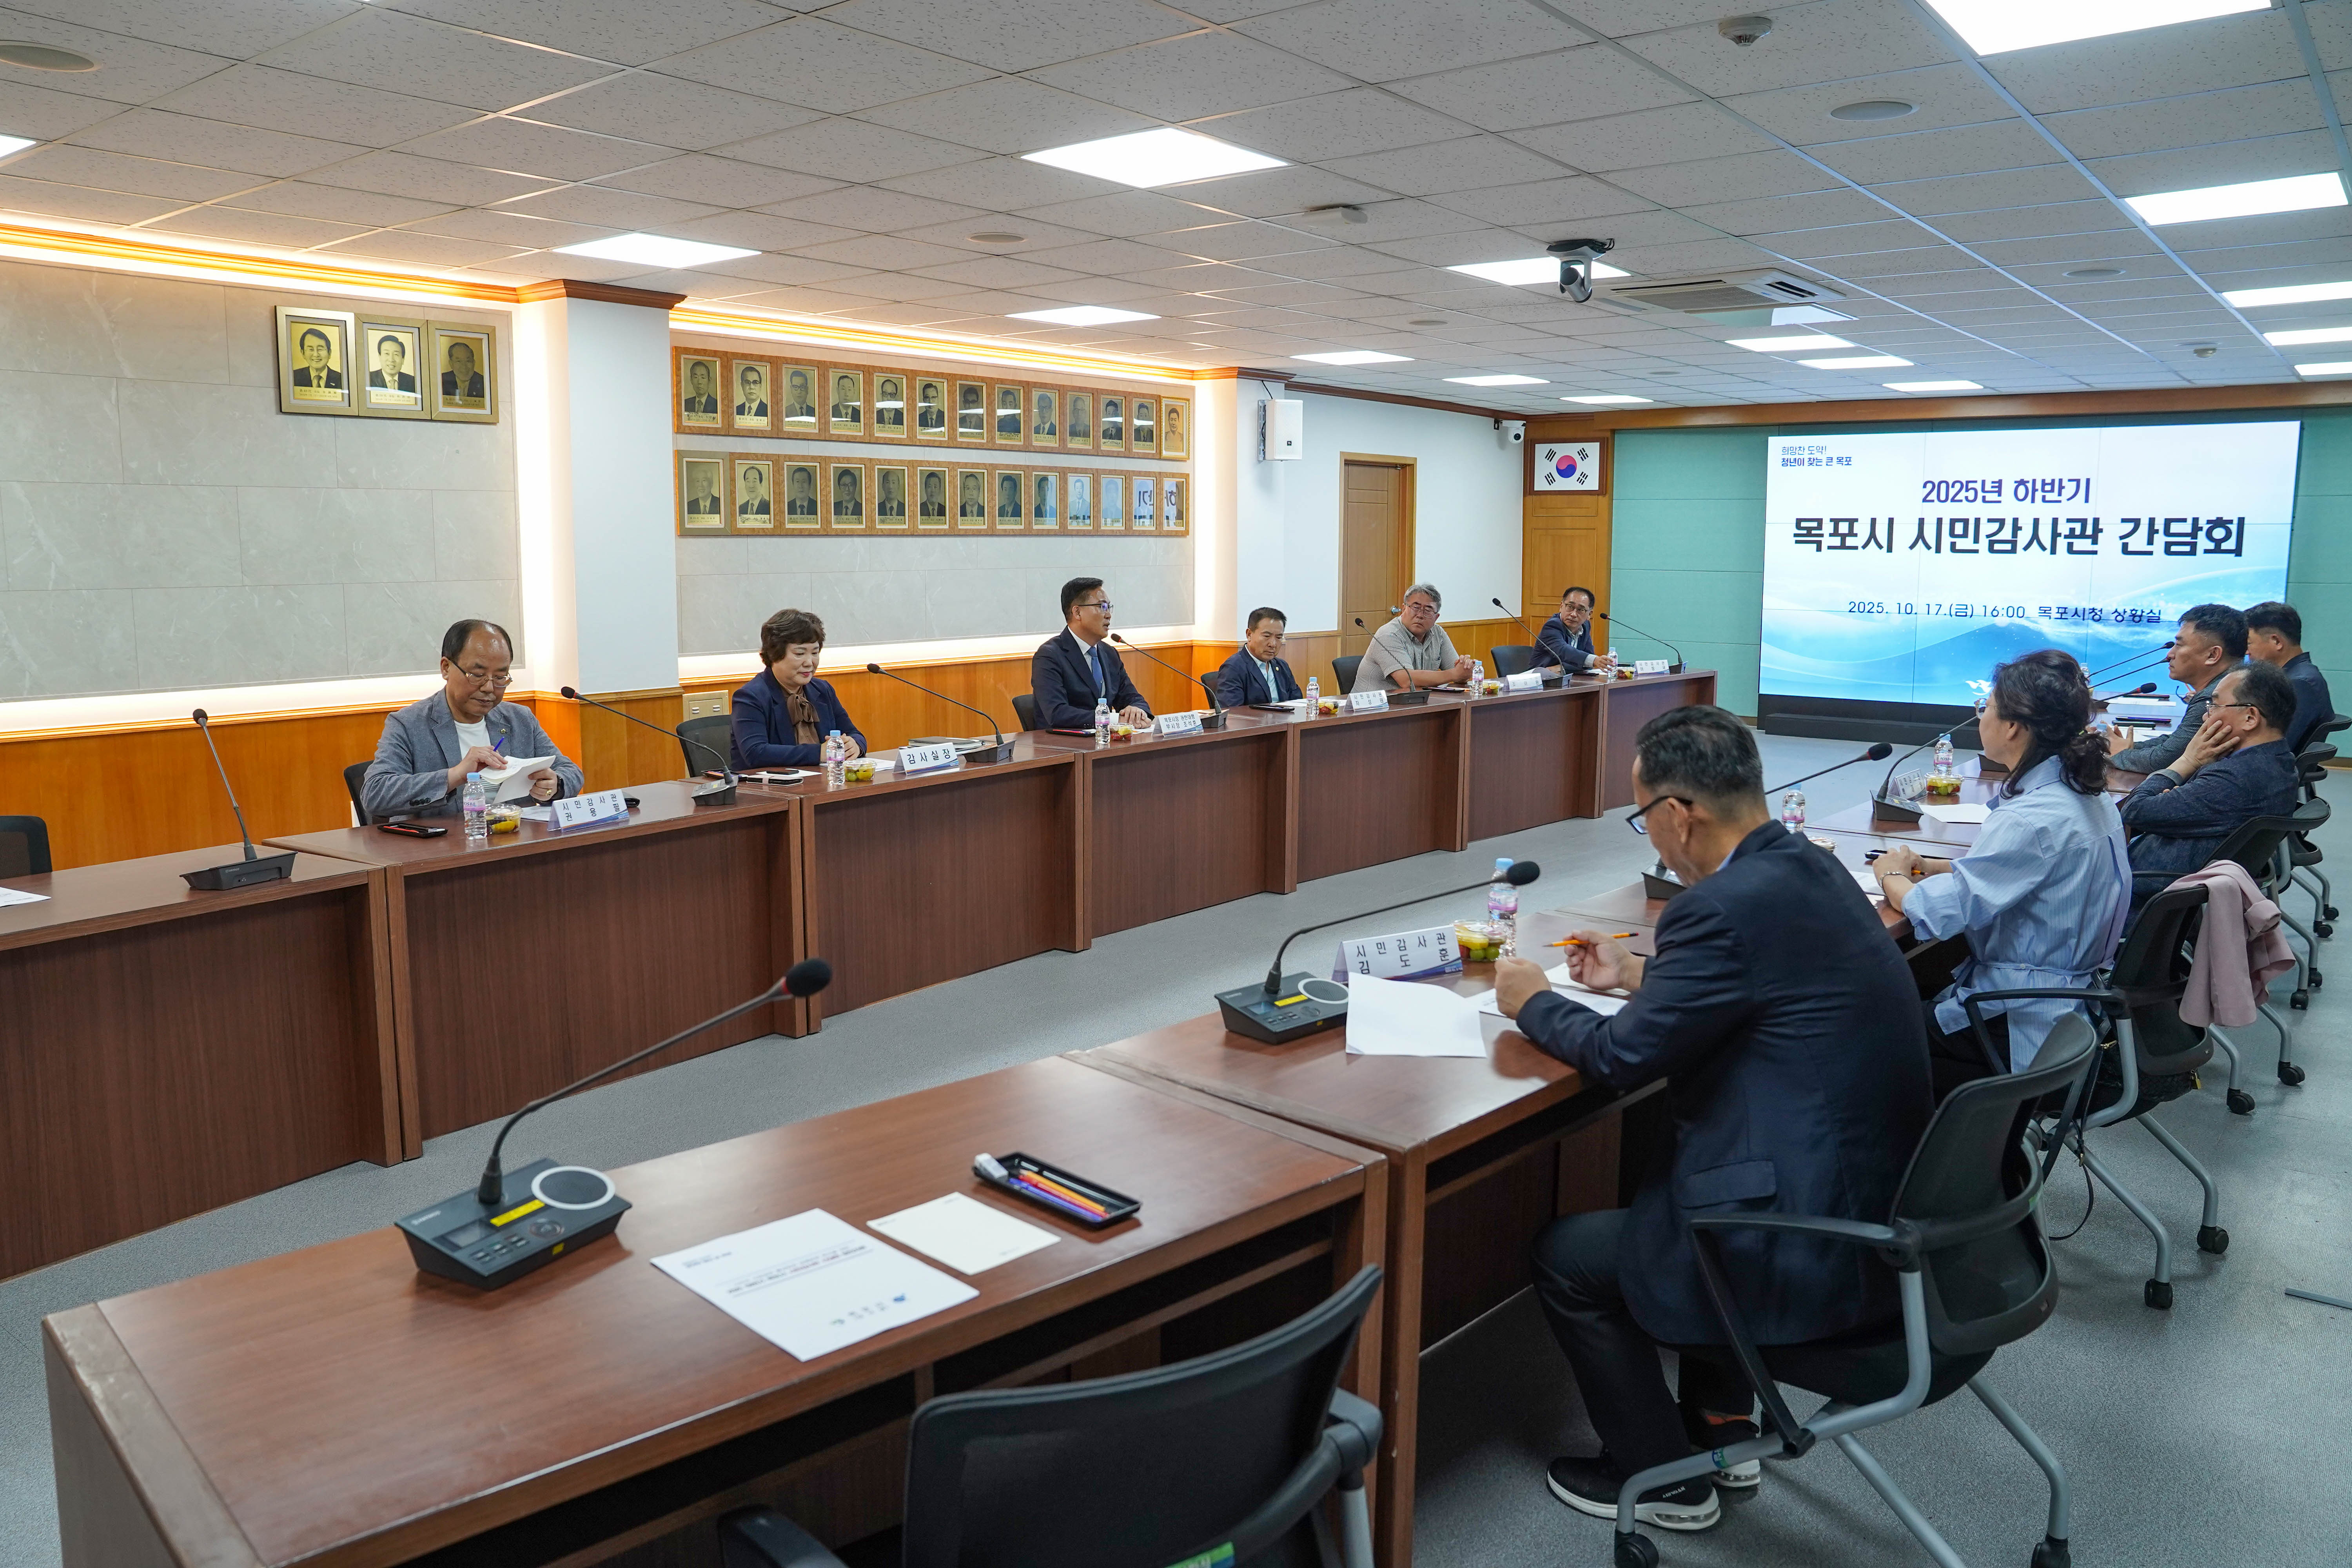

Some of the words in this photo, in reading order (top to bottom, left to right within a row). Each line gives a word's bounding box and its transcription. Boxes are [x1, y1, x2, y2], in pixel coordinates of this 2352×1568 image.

[1782, 446, 1805, 455] 희망찬
[1808, 445, 1826, 455] 도약!
[1781, 457, 1804, 466] 청년이
[1808, 457, 1823, 466] 찾는
[1826, 457, 1833, 466] 큰
[1836, 457, 1852, 466] 목포
[1922, 479, 2003, 503] 2025년
[2014, 477, 2091, 504] 하반기
[1793, 517, 1894, 553] 목포시
[1908, 517, 2103, 555] 시민감사관
[2118, 516, 2246, 557] 간담회
[1848, 602, 1888, 614] 2025.
[1897, 603, 1917, 615] 10.
[1926, 603, 1974, 618] 17.(금)
[1982, 605, 2025, 618] 16:00
[2038, 605, 2103, 622] 목포시청
[2111, 608, 2162, 624] 상황실
[907, 749, 951, 764] 감사실장
[562, 793, 617, 811] 시민감사관
[565, 803, 621, 821] 권용필
[1356, 932, 1446, 957] 시민감사관
[1359, 948, 1450, 975] 김도훈
